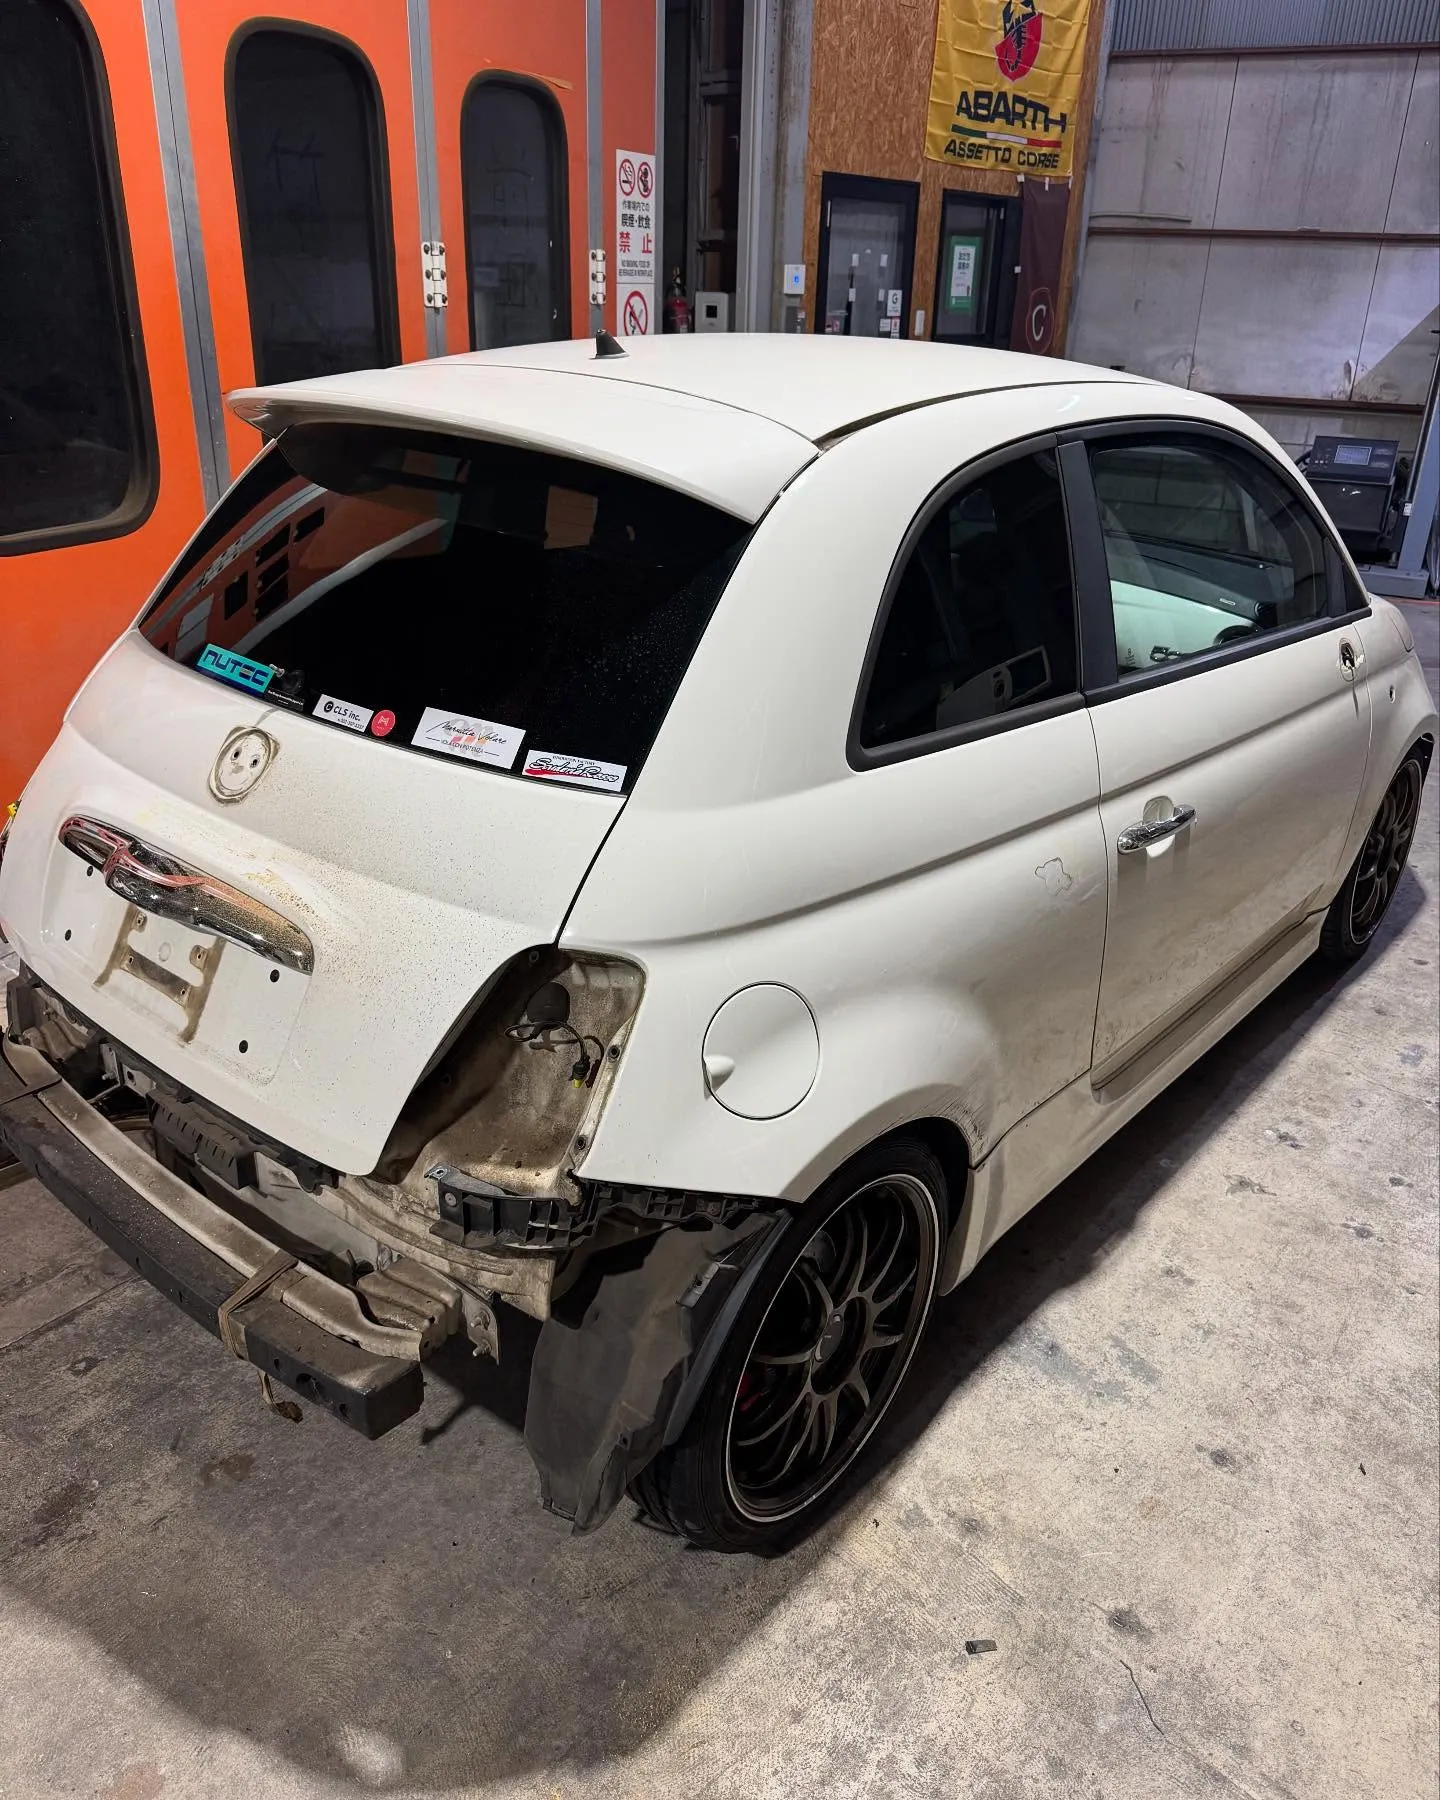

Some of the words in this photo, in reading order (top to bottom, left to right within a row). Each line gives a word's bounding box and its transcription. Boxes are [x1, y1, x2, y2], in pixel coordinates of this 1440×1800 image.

[956, 90, 1067, 133] ABARTH
[944, 139, 1012, 164] ASSETTO
[1017, 150, 1061, 169] CORSE
[333, 705, 348, 717] CLS
[348, 711, 361, 721] inc.
